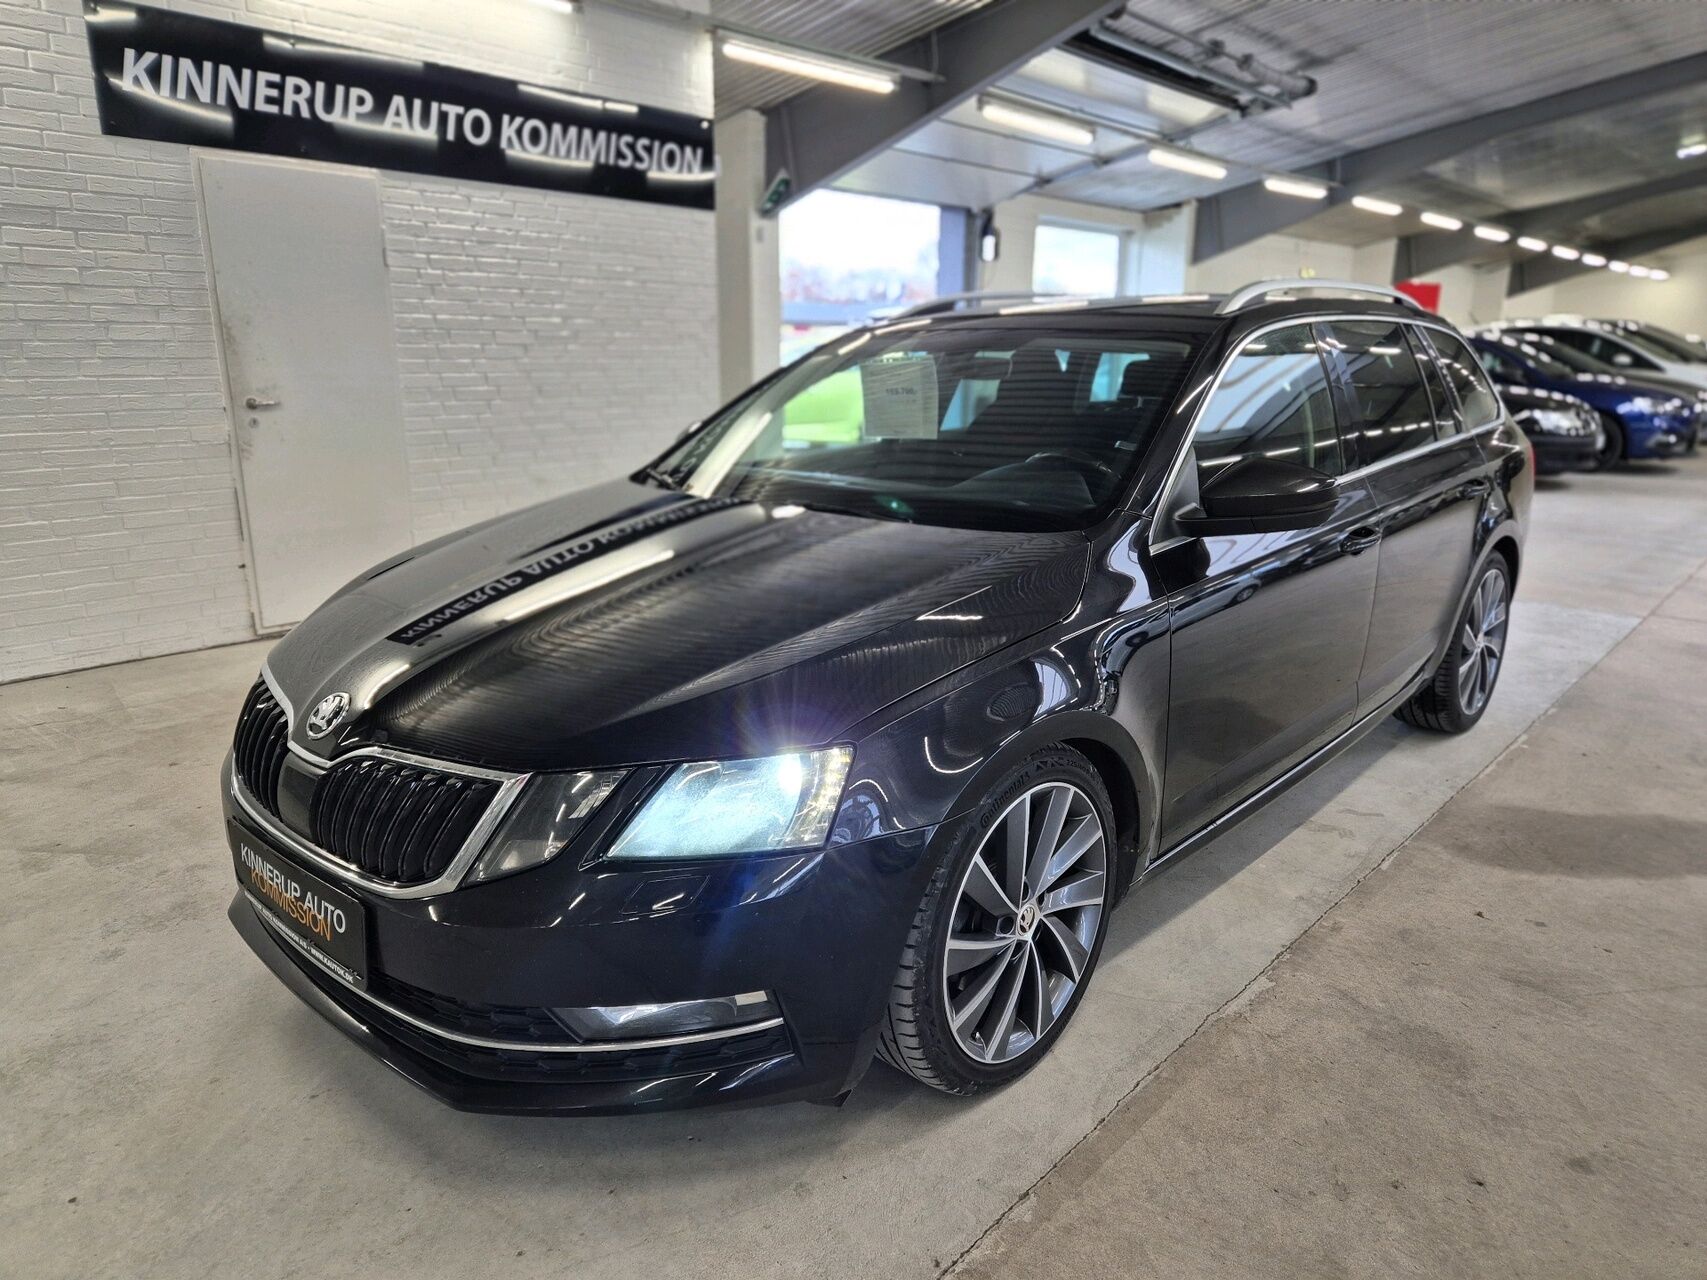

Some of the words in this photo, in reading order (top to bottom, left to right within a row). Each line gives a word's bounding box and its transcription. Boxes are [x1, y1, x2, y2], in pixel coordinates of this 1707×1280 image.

[122, 47, 374, 123] KINNERUP
[381, 94, 493, 146] AUTO
[500, 114, 703, 174] KOMMISSION
[241, 843, 301, 898] KINNERUP
[303, 891, 346, 934] AUTO
[251, 869, 333, 942] KOMMISSION
